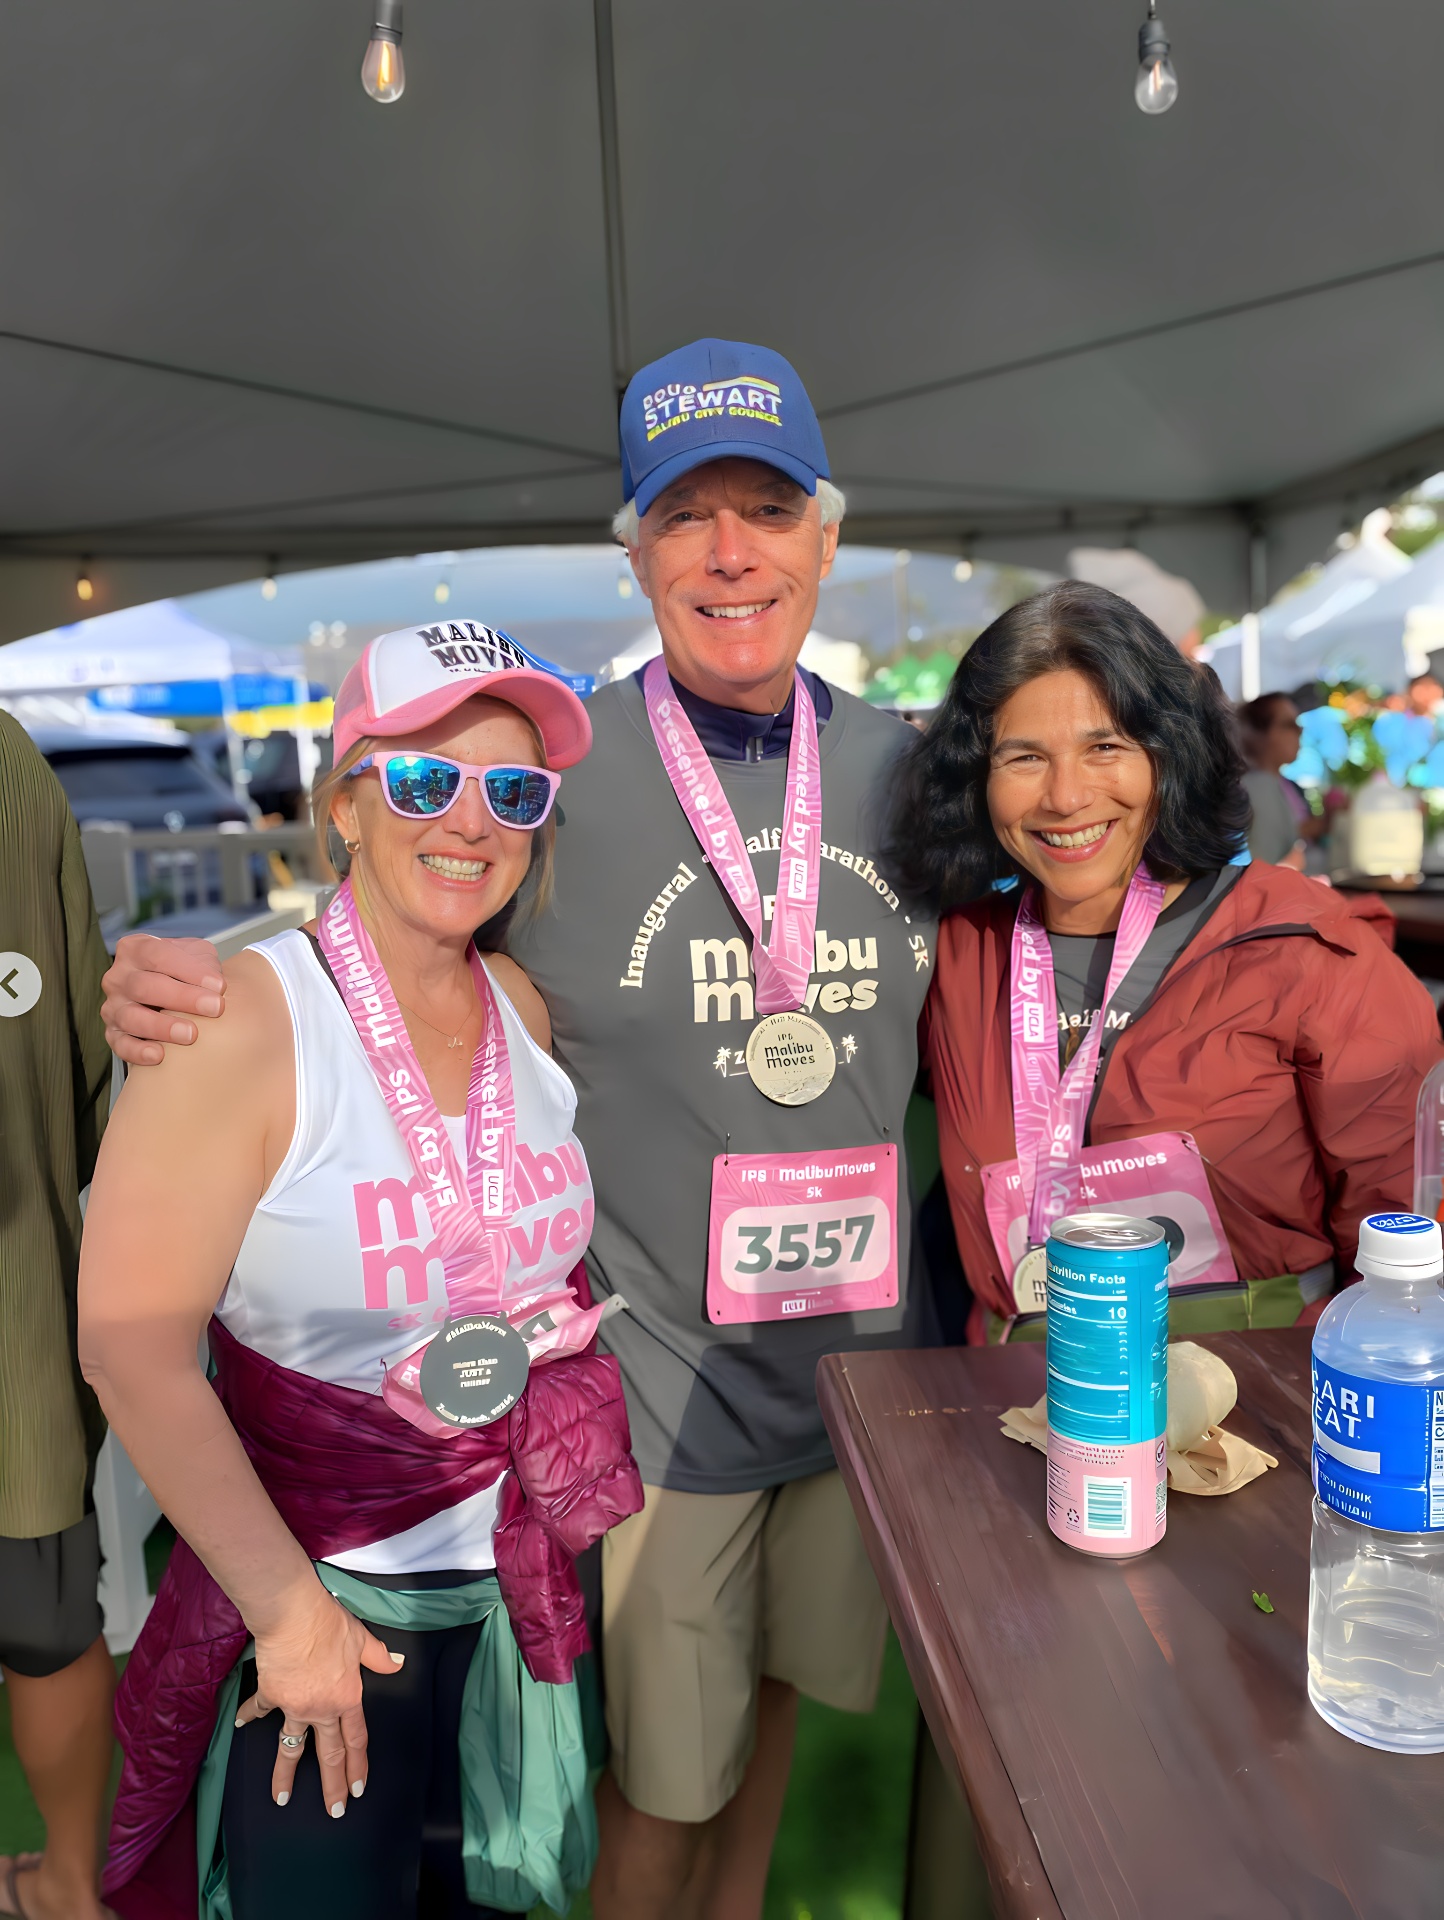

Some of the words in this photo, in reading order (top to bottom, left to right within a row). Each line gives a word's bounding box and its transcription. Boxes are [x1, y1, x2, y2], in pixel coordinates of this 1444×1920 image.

[645, 388, 782, 430] STEWART
[430, 645, 524, 669] MOVE
[710, 829, 734, 861] by
[787, 821, 811, 856] by
[792, 863, 805, 894] UCLA
[619, 861, 698, 988] Inaugural
[745, 827, 782, 854] alf
[819, 840, 900, 911] arathon
[908, 934, 929, 972] 5K
[1017, 967, 1043, 999] by
[1028, 1007, 1040, 1038] UCLA
[388, 1068, 423, 1116] IPS
[412, 1125, 440, 1163] by
[476, 1127, 504, 1164] by
[1050, 1124, 1072, 1168] IPS
[427, 1165, 458, 1208] 5K
[488, 1175, 501, 1211] UCLA
[1006, 1174, 1021, 1191] IP
[734, 1214, 876, 1275] 3557
[1108, 1306, 1127, 1320] 10
